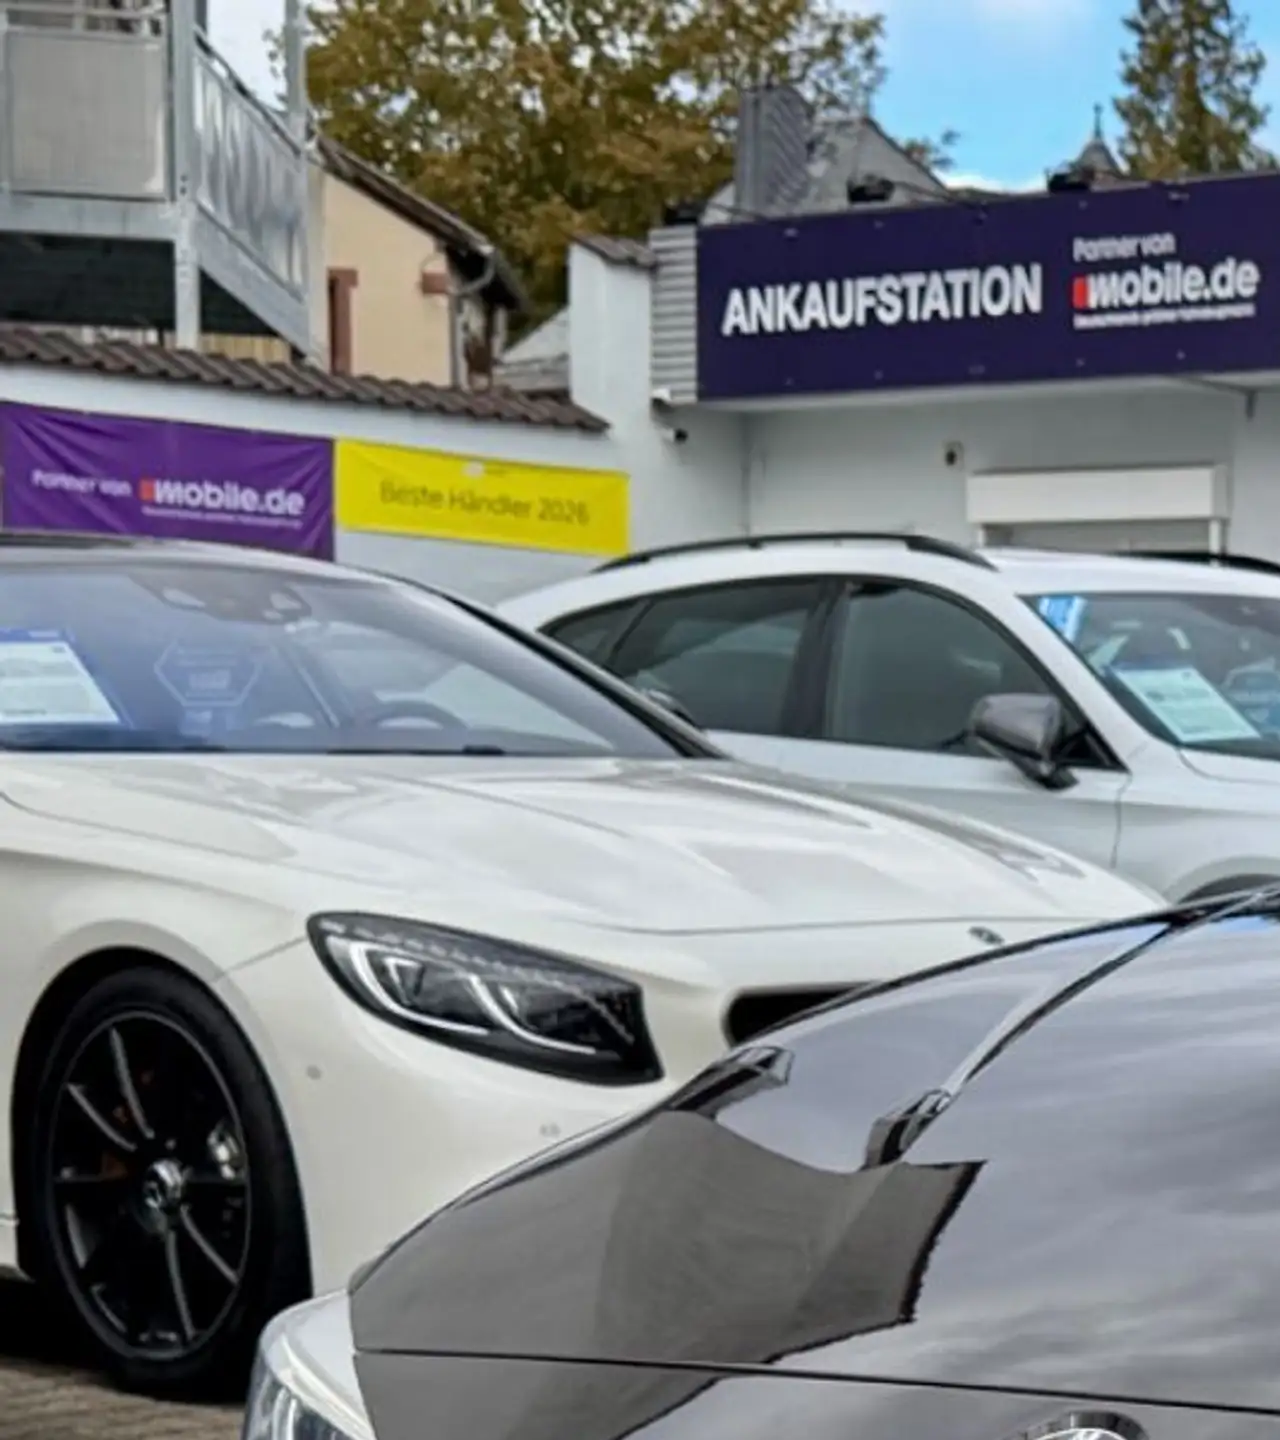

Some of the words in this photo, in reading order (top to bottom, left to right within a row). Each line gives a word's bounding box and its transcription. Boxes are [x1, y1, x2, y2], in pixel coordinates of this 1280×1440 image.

[721, 263, 1042, 336] ANKAUFSTATION
[1088, 257, 1259, 308] mobile.de
[155, 478, 305, 515] mobile.de
[380, 479, 443, 508] Beste
[449, 488, 530, 519] Händler
